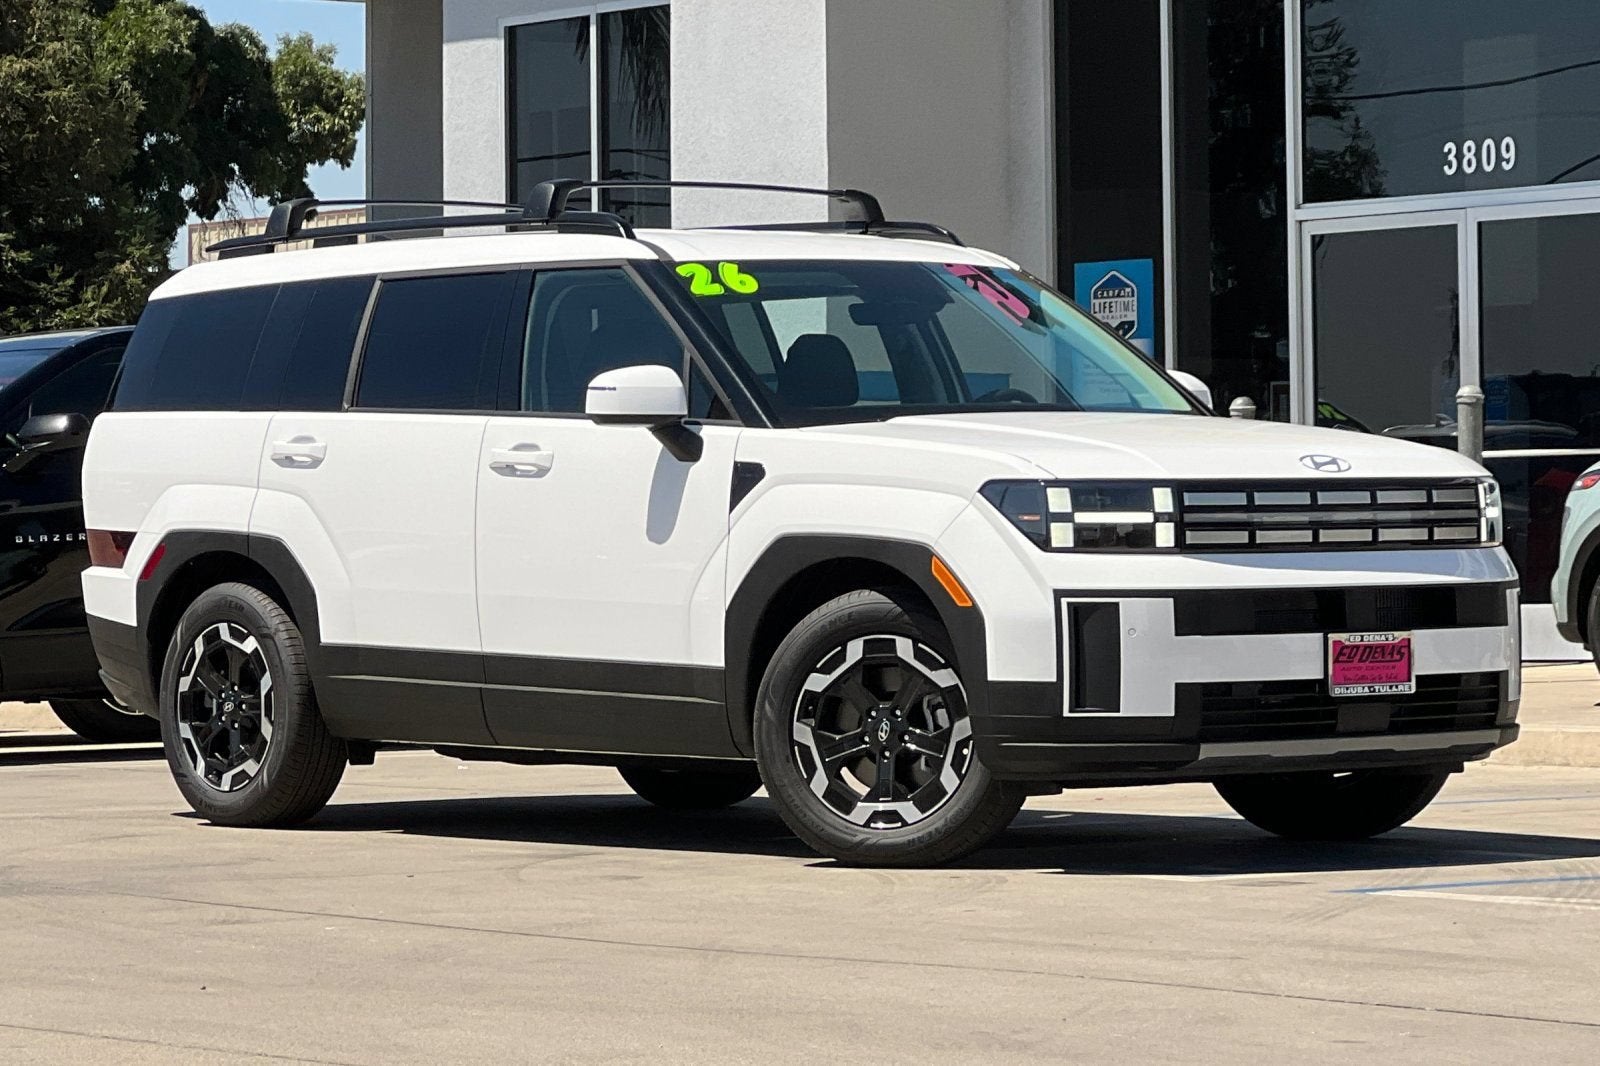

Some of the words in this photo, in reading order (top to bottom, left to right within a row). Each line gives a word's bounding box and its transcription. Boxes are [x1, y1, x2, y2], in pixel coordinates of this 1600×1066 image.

[1443, 136, 1516, 176] 3809
[675, 261, 759, 297] 26
[1092, 299, 1136, 315] LIFETIME
[1101, 313, 1129, 321] DEALER
[15, 532, 87, 543] BLAZER
[1363, 634, 1394, 642] DENA'S
[1333, 645, 1360, 664] ED
[1373, 684, 1411, 693] TULARE
